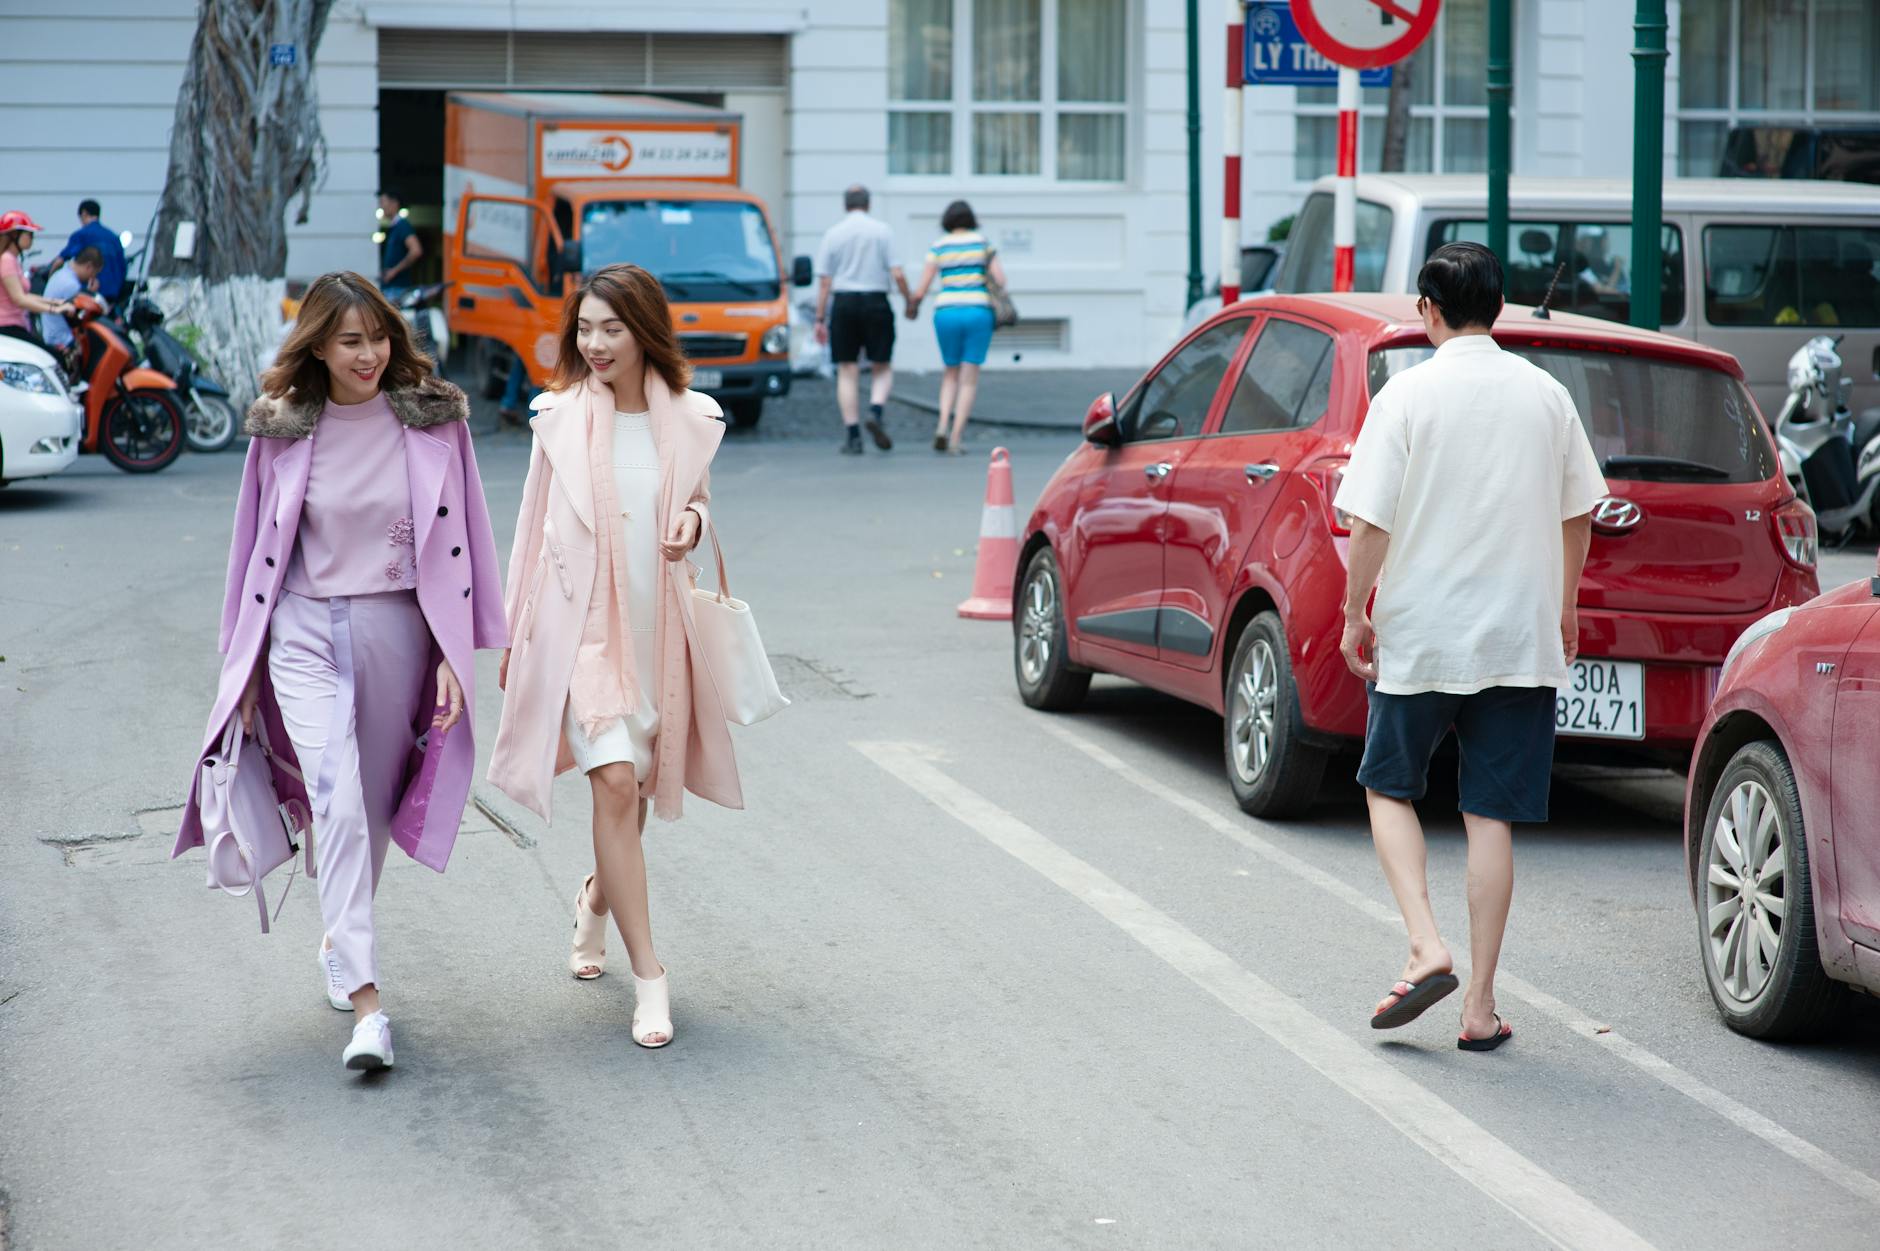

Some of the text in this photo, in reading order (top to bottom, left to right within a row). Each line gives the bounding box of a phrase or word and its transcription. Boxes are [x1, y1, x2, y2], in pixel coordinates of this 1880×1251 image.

[1254, 36, 1283, 70] LÝ
[1573, 662, 1621, 695] 30A
[1556, 696, 1637, 733] 824.71
